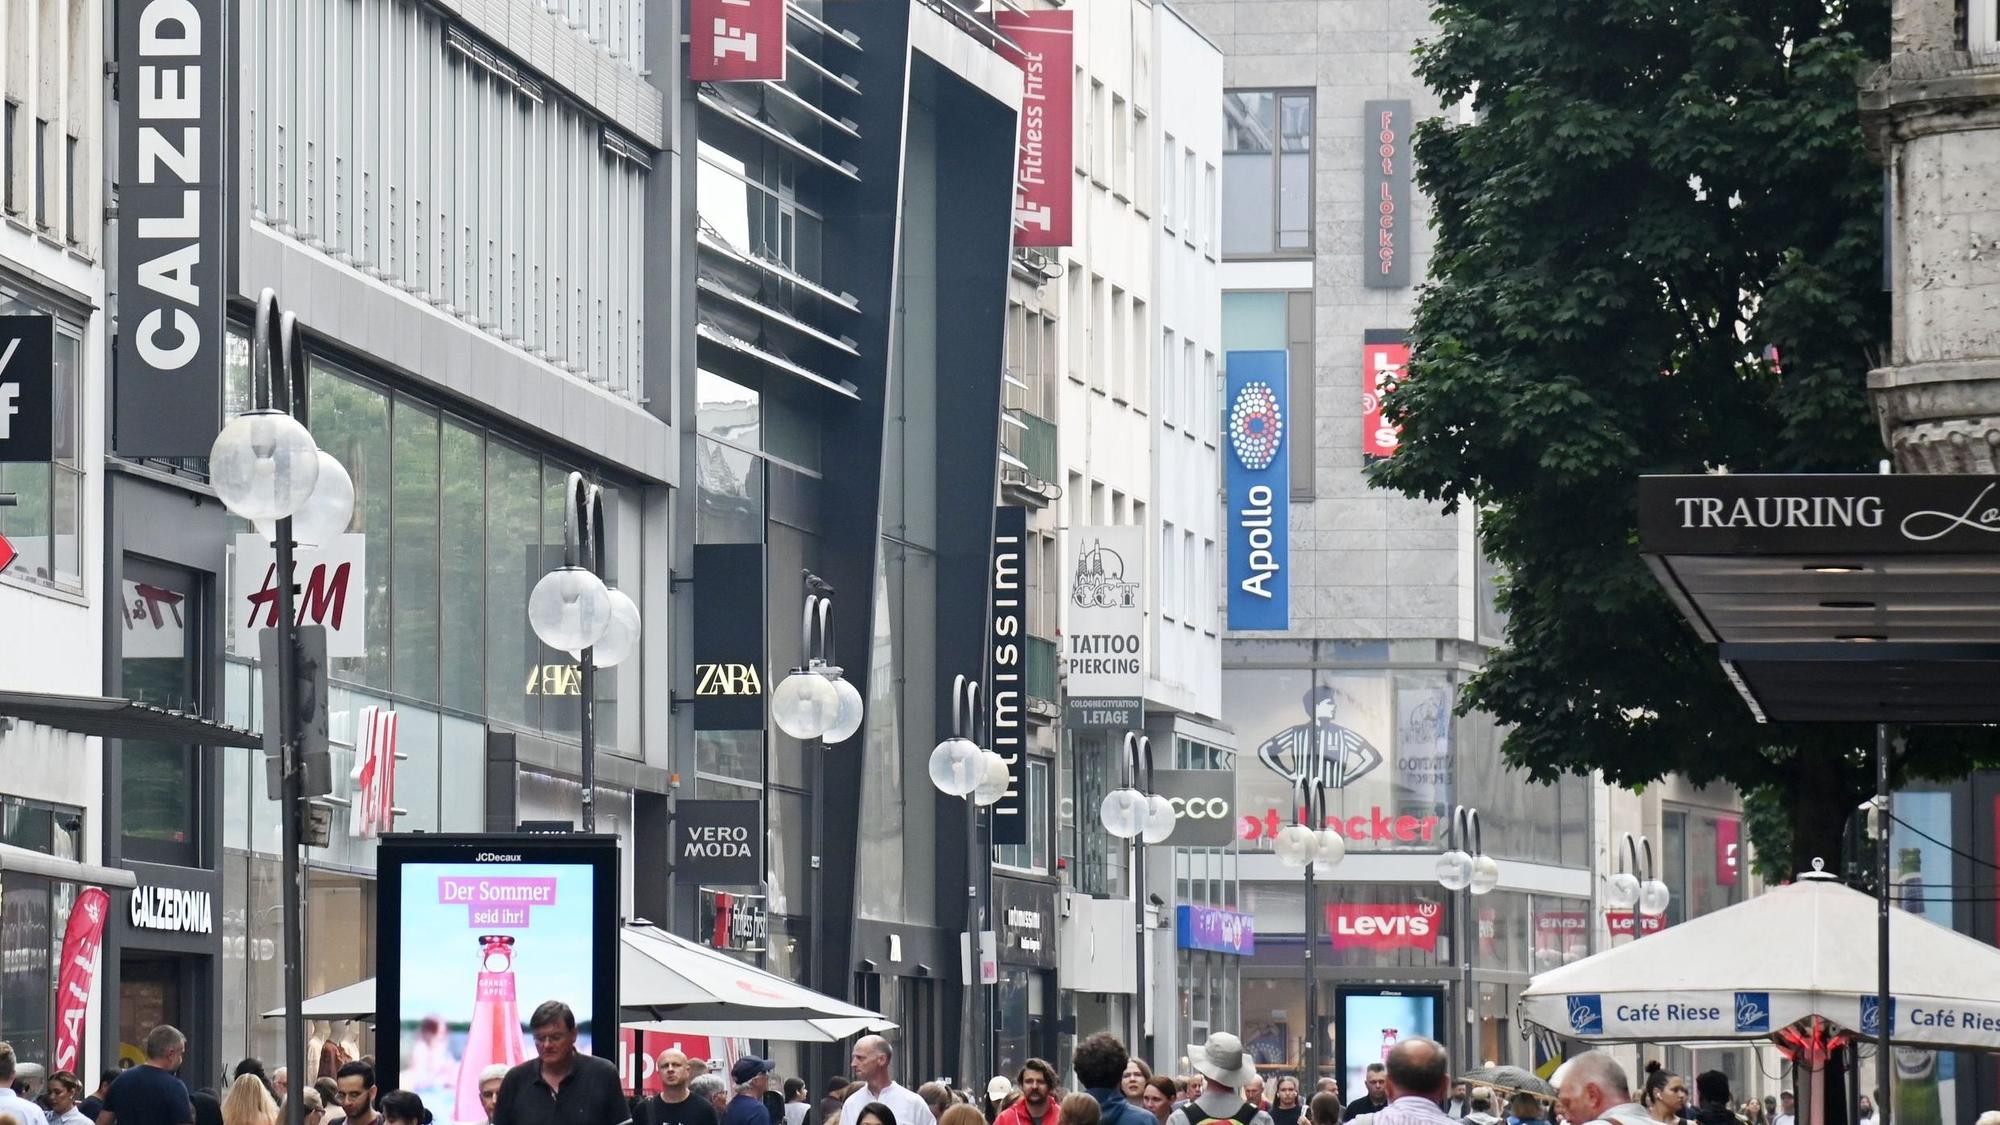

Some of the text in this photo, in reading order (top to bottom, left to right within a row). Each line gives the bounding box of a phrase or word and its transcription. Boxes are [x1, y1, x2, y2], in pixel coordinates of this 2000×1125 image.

[1379, 111, 1394, 274] Foot Locker
[1675, 496, 1885, 528] TRAURING
[1241, 485, 1279, 599] Apollo
[1071, 635, 1140, 654] TATTOO
[1070, 658, 1140, 674] PIERCING
[695, 663, 761, 695] ZARA
[1082, 711, 1129, 725] 1.ETAGE
[688, 827, 748, 841] VERO
[475, 852, 522, 862] JCDecaux
[684, 843, 752, 857] MODA
[444, 881, 551, 901] Der Sommer
[131, 886, 212, 933] CALZEDONIA
[474, 908, 524, 924] seid ihr!
[1617, 1003, 1660, 1021] Café
[1667, 1003, 1720, 1020] Riese
[1910, 1008, 1955, 1027] Café
